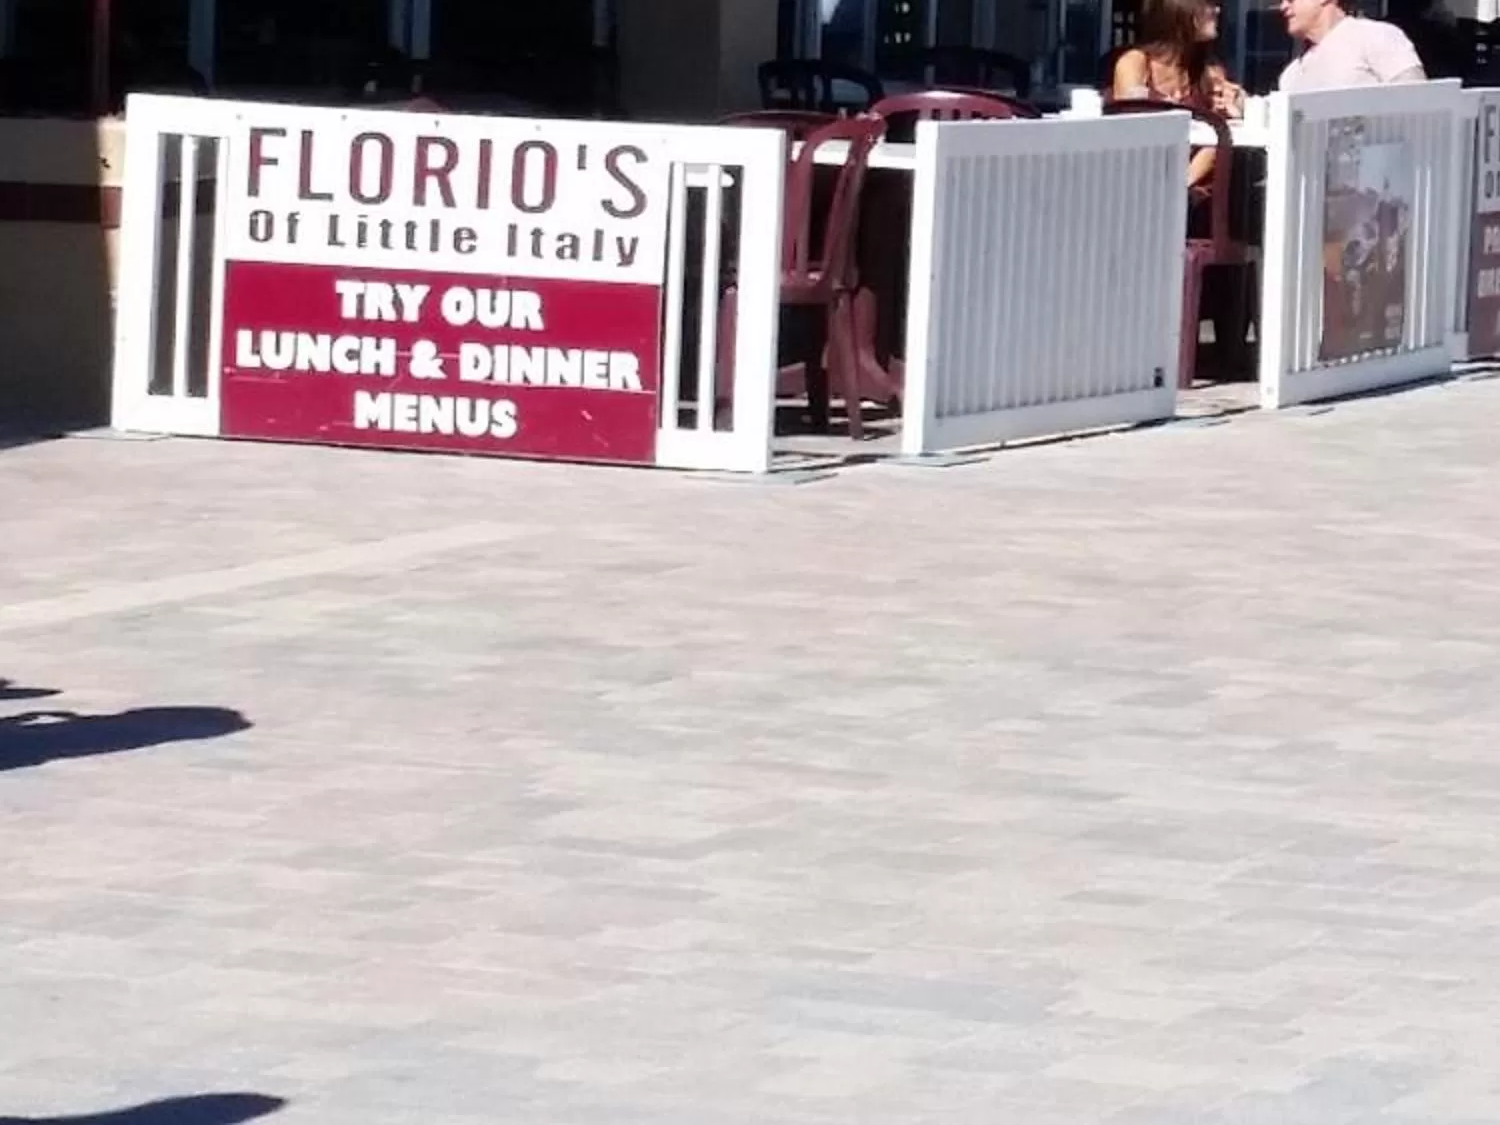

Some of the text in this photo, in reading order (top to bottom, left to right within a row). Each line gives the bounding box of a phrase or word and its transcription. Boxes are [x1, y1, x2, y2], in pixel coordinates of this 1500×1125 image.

[246, 126, 649, 219] FLORIO'S
[248, 209, 640, 267] Of Little Italy
[335, 280, 544, 331] TRY OUR
[235, 329, 642, 391] LUNCH & DINNER
[353, 391, 518, 438] MENUS
